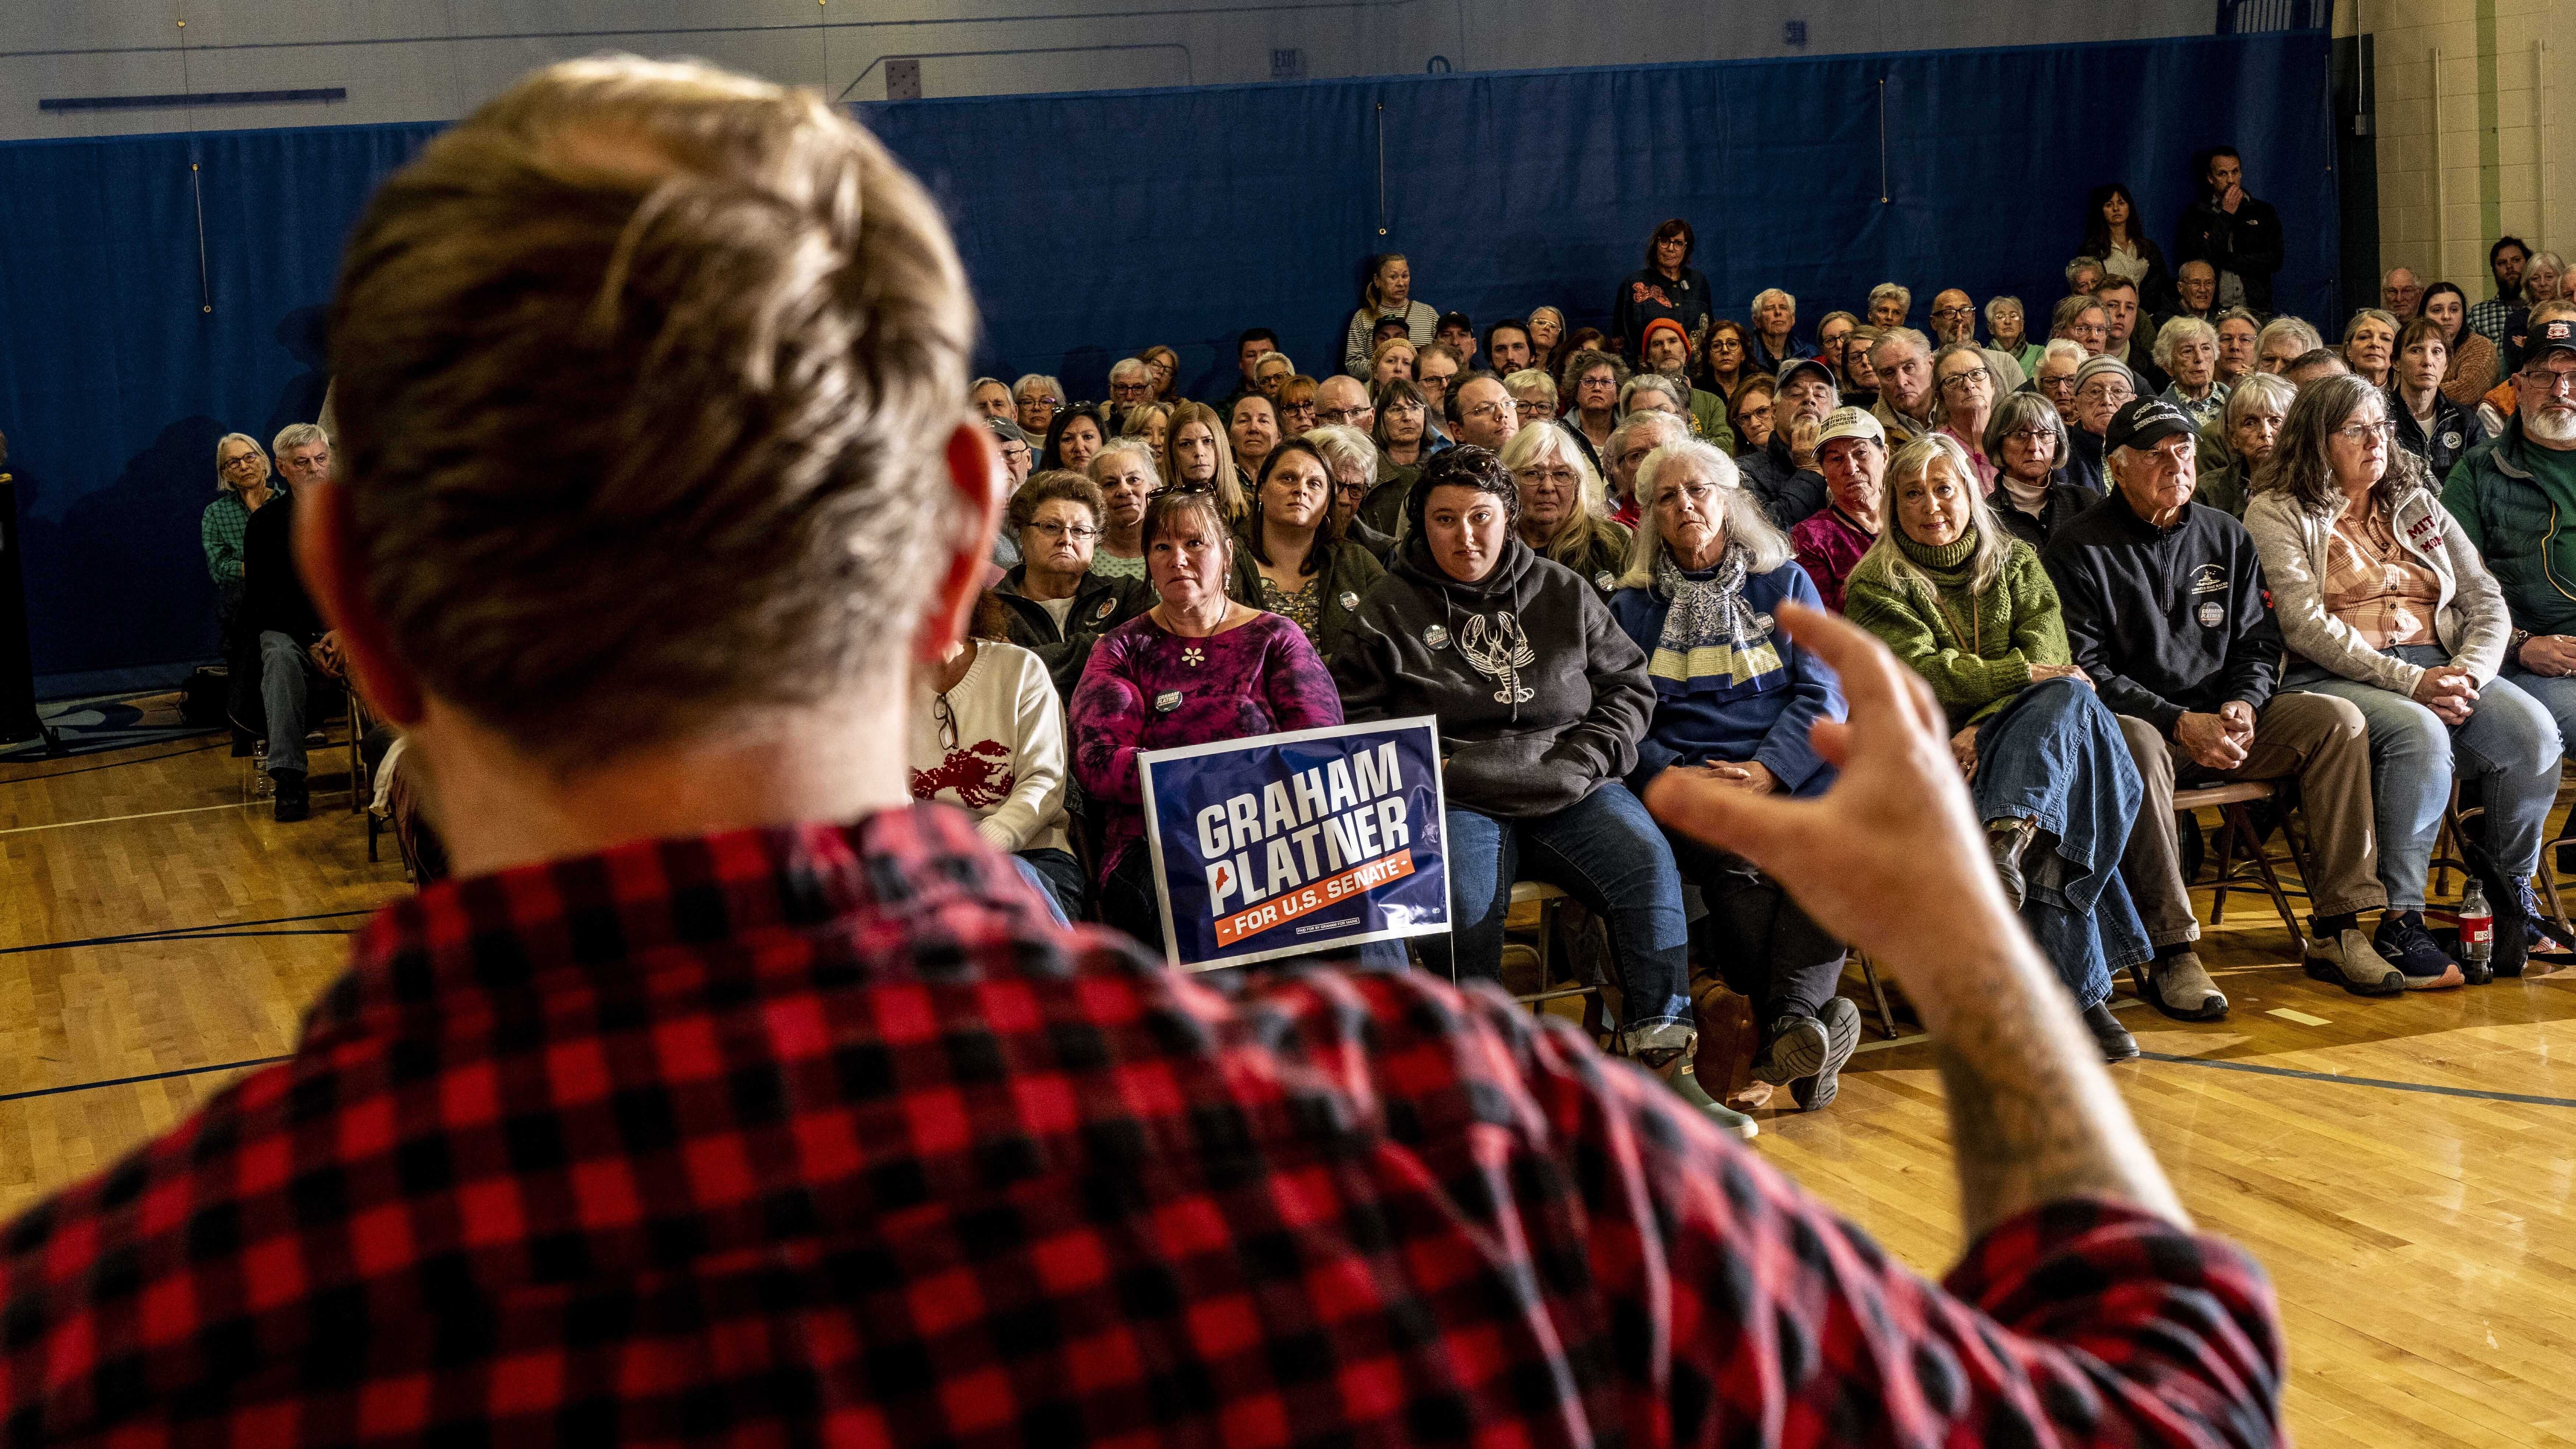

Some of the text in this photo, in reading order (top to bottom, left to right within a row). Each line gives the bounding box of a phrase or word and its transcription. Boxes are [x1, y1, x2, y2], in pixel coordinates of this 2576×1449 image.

[1829, 420, 1858, 429] ORCHESTRA
[1830, 416, 1857, 425] SYMPHONY
[2133, 415, 2158, 431] DUTCH
[2406, 515, 2435, 540] MIT
[1426, 627, 1446, 638] GRAHAM
[1427, 632, 1447, 643] PLATNER
[1157, 695, 1178, 705] PLATNER
[1158, 691, 1180, 700] GRAHAM
[1196, 740, 1402, 859] GRAHAM
[1205, 796, 1409, 917] PLATNER
[1234, 858, 1399, 935] FOR U.S. SENATE
